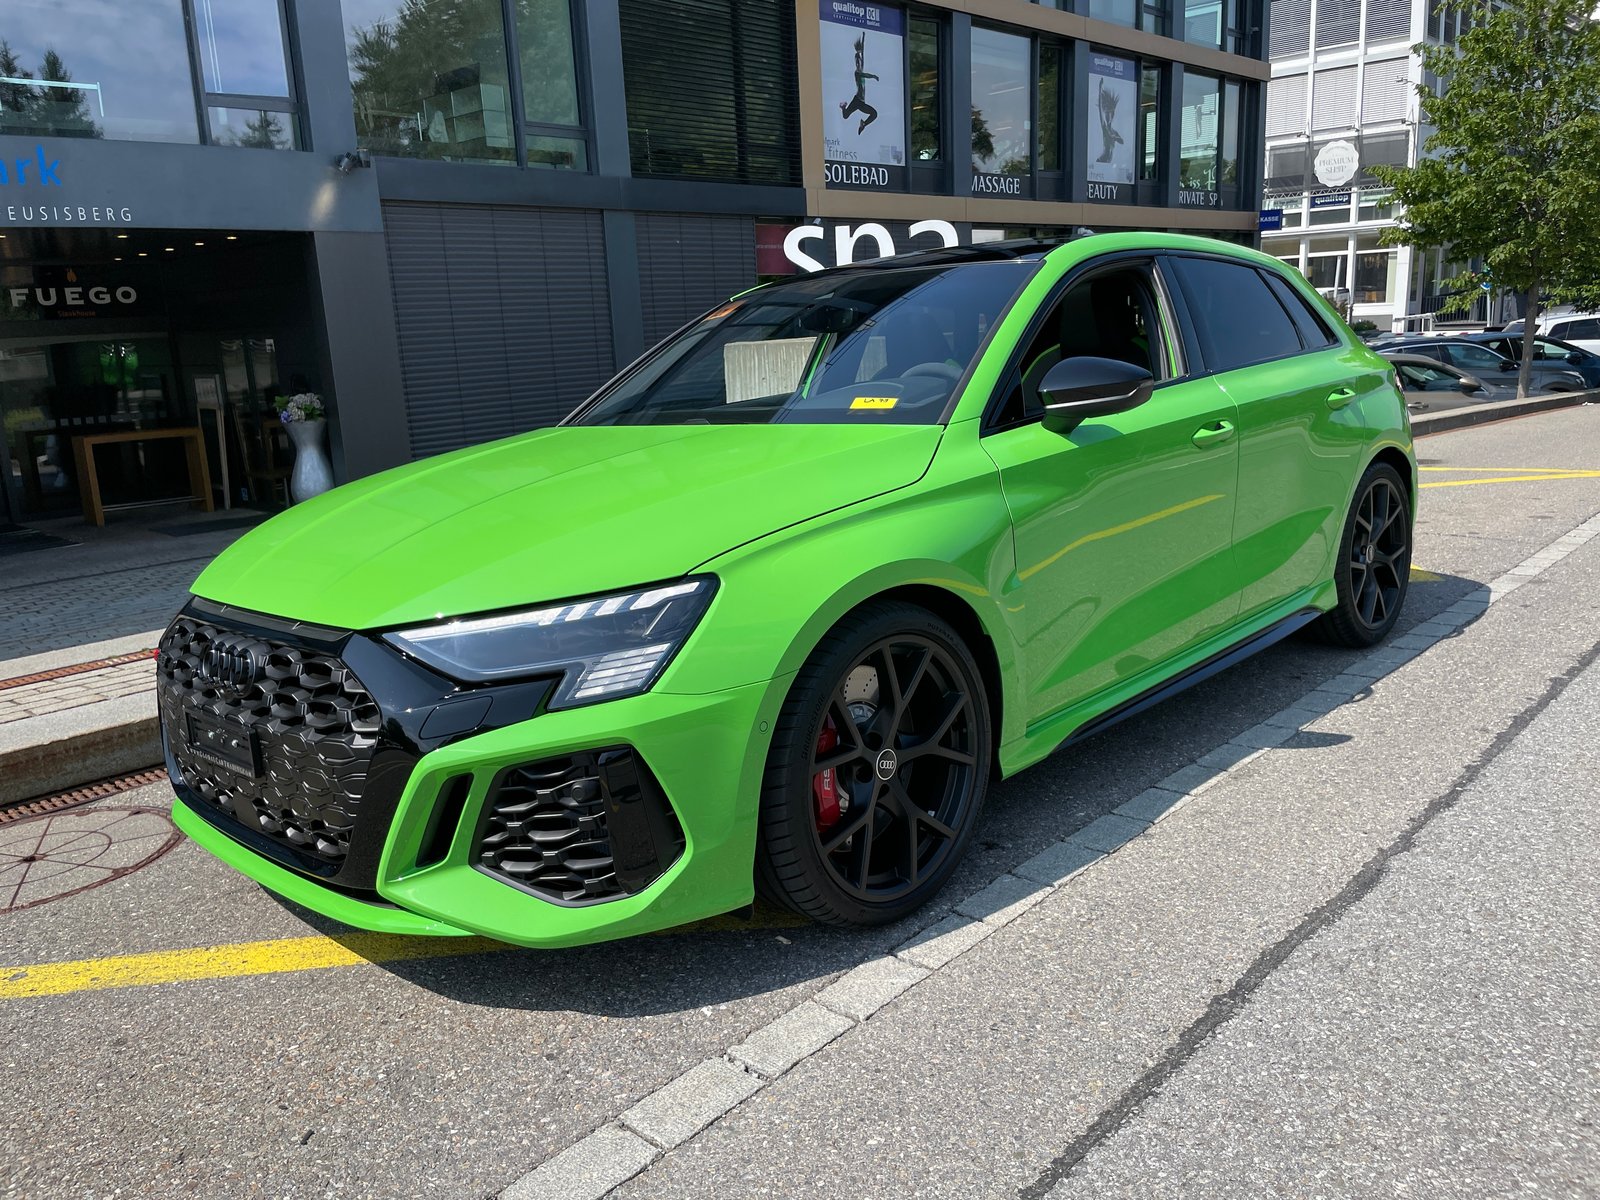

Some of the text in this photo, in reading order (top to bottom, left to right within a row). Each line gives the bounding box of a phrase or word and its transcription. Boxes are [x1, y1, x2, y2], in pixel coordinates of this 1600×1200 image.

[832, 2, 865, 17] qualitop
[829, 145, 858, 160] fitness
[824, 163, 889, 187] SOLEBAD
[1086, 184, 1118, 200] EAUTY
[1314, 194, 1349, 205] qualitop
[0, 205, 133, 223] EUSISBERG
[1259, 215, 1280, 223] KASSE
[9, 286, 138, 307] FUEGO
[823, 768, 831, 791] RS
